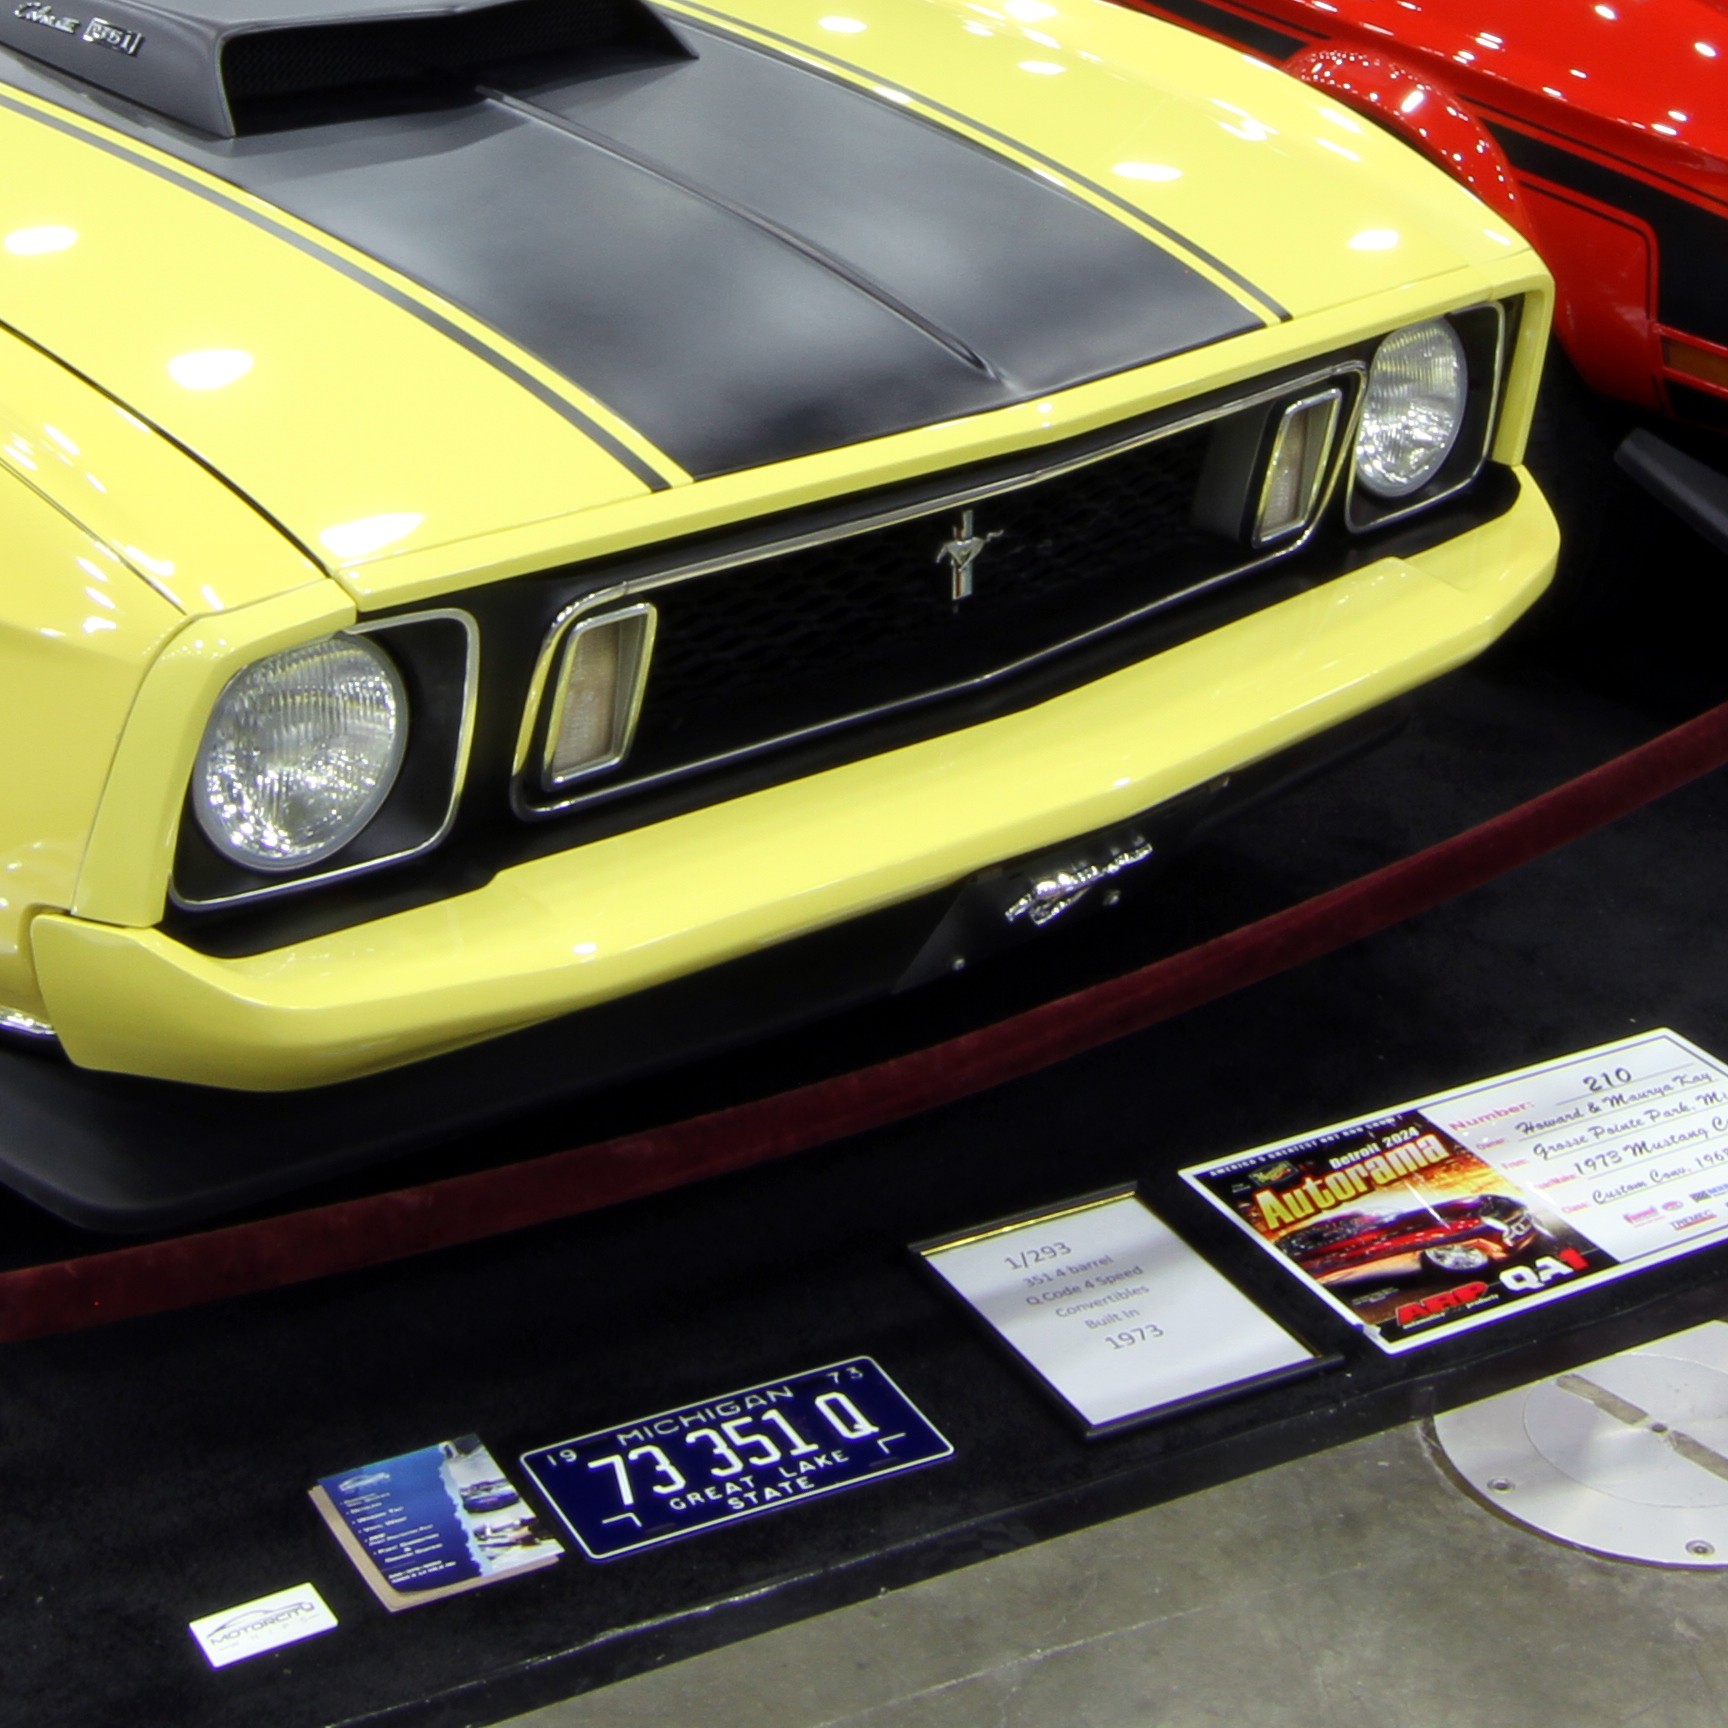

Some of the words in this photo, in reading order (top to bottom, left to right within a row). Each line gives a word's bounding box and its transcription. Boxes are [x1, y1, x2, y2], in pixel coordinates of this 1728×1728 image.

[1448, 1099, 1536, 1132] Number:
[1582, 1066, 1633, 1093] 210
[1515, 1106, 1584, 1136] Howard
[1586, 1101, 1599, 1115] &
[1673, 1071, 1714, 1090] Kay
[1328, 1142, 1381, 1170] Detroit
[1382, 1126, 1420, 1147] 2024
[1532, 1134, 1590, 1160] Grosse
[1587, 1116, 1646, 1140] Pointe
[1574, 1149, 1623, 1176] 1973
[1622, 1126, 1709, 1158] Mustang
[1254, 1133, 1450, 1231] Autorama
[1592, 1176, 1648, 1205] Custom
[1004, 1242, 1072, 1270] 1/293
[1024, 1273, 1054, 1288] 351
[1055, 1268, 1067, 1278] 4
[1066, 1254, 1115, 1275] barrel
[1499, 1247, 1589, 1292] QA1
[1026, 1295, 1042, 1307] Q
[1042, 1285, 1082, 1301] Code
[1084, 1279, 1096, 1290] 4
[1096, 1265, 1144, 1286] Speed
[1055, 1285, 1150, 1318] Convertibles
[1396, 1281, 1489, 1325] ARP
[1084, 1311, 1122, 1330] Built
[1105, 1323, 1165, 1350] 1973
[545, 1447, 579, 1467] 19
[616, 1385, 795, 1447] MICHIGAN
[825, 1365, 865, 1386] 73
[587, 1444, 688, 1507] 73
[685, 1408, 820, 1479] 351
[814, 1390, 880, 1441] Q
[669, 1474, 756, 1512] GREAT
[779, 1448, 850, 1479] LAKE
[726, 1475, 815, 1512] STATE
